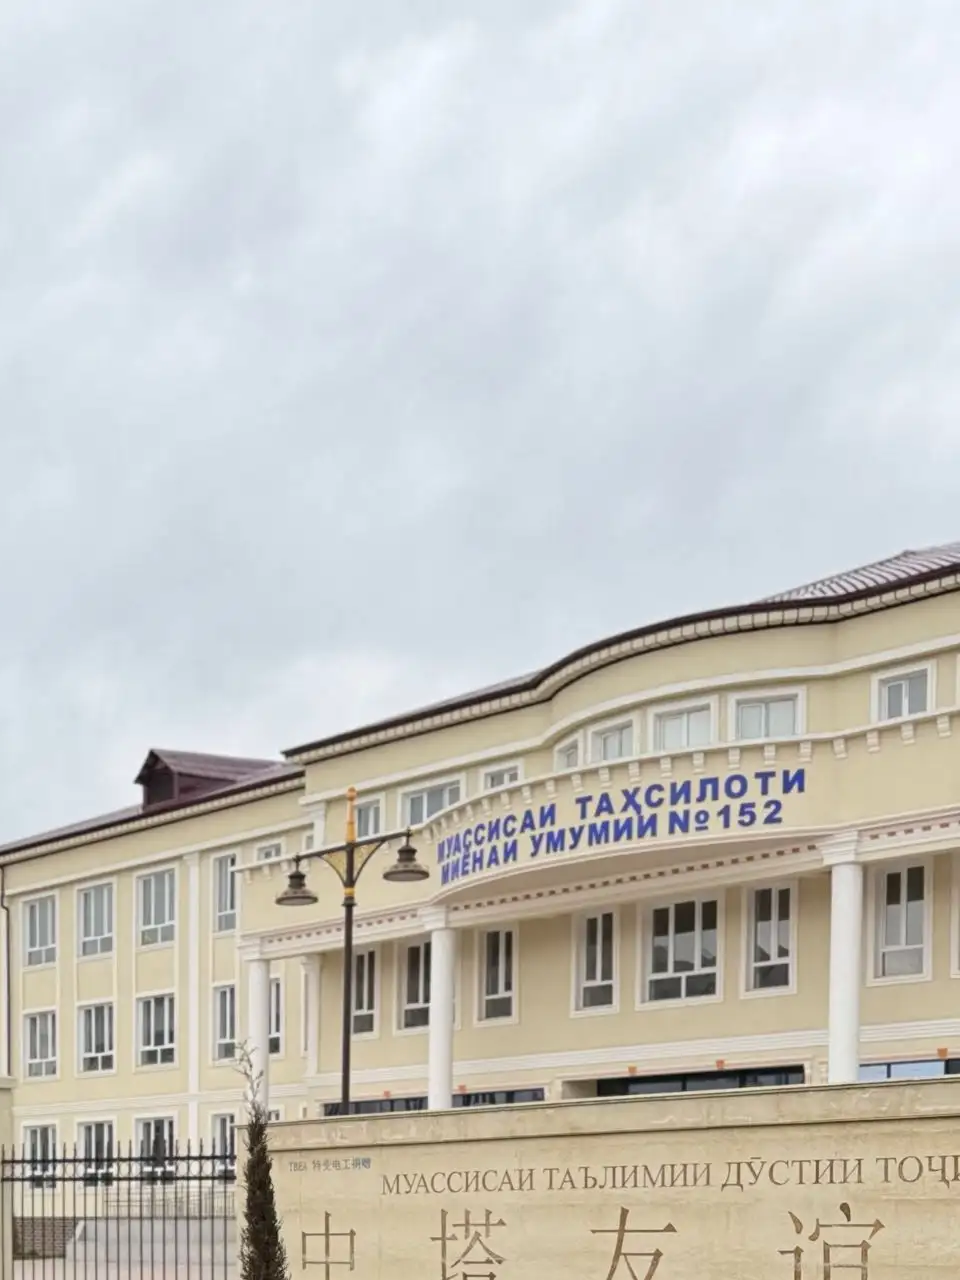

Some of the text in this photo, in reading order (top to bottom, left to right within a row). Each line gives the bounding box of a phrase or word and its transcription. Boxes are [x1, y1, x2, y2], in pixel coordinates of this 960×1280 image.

[437, 803, 556, 864] МУАССИСАИ
[530, 813, 658, 857] УМУМИИ
[381, 1168, 535, 1195] МУАССИСАИ
[543, 1162, 712, 1190] ТАЪЛИМИИ
